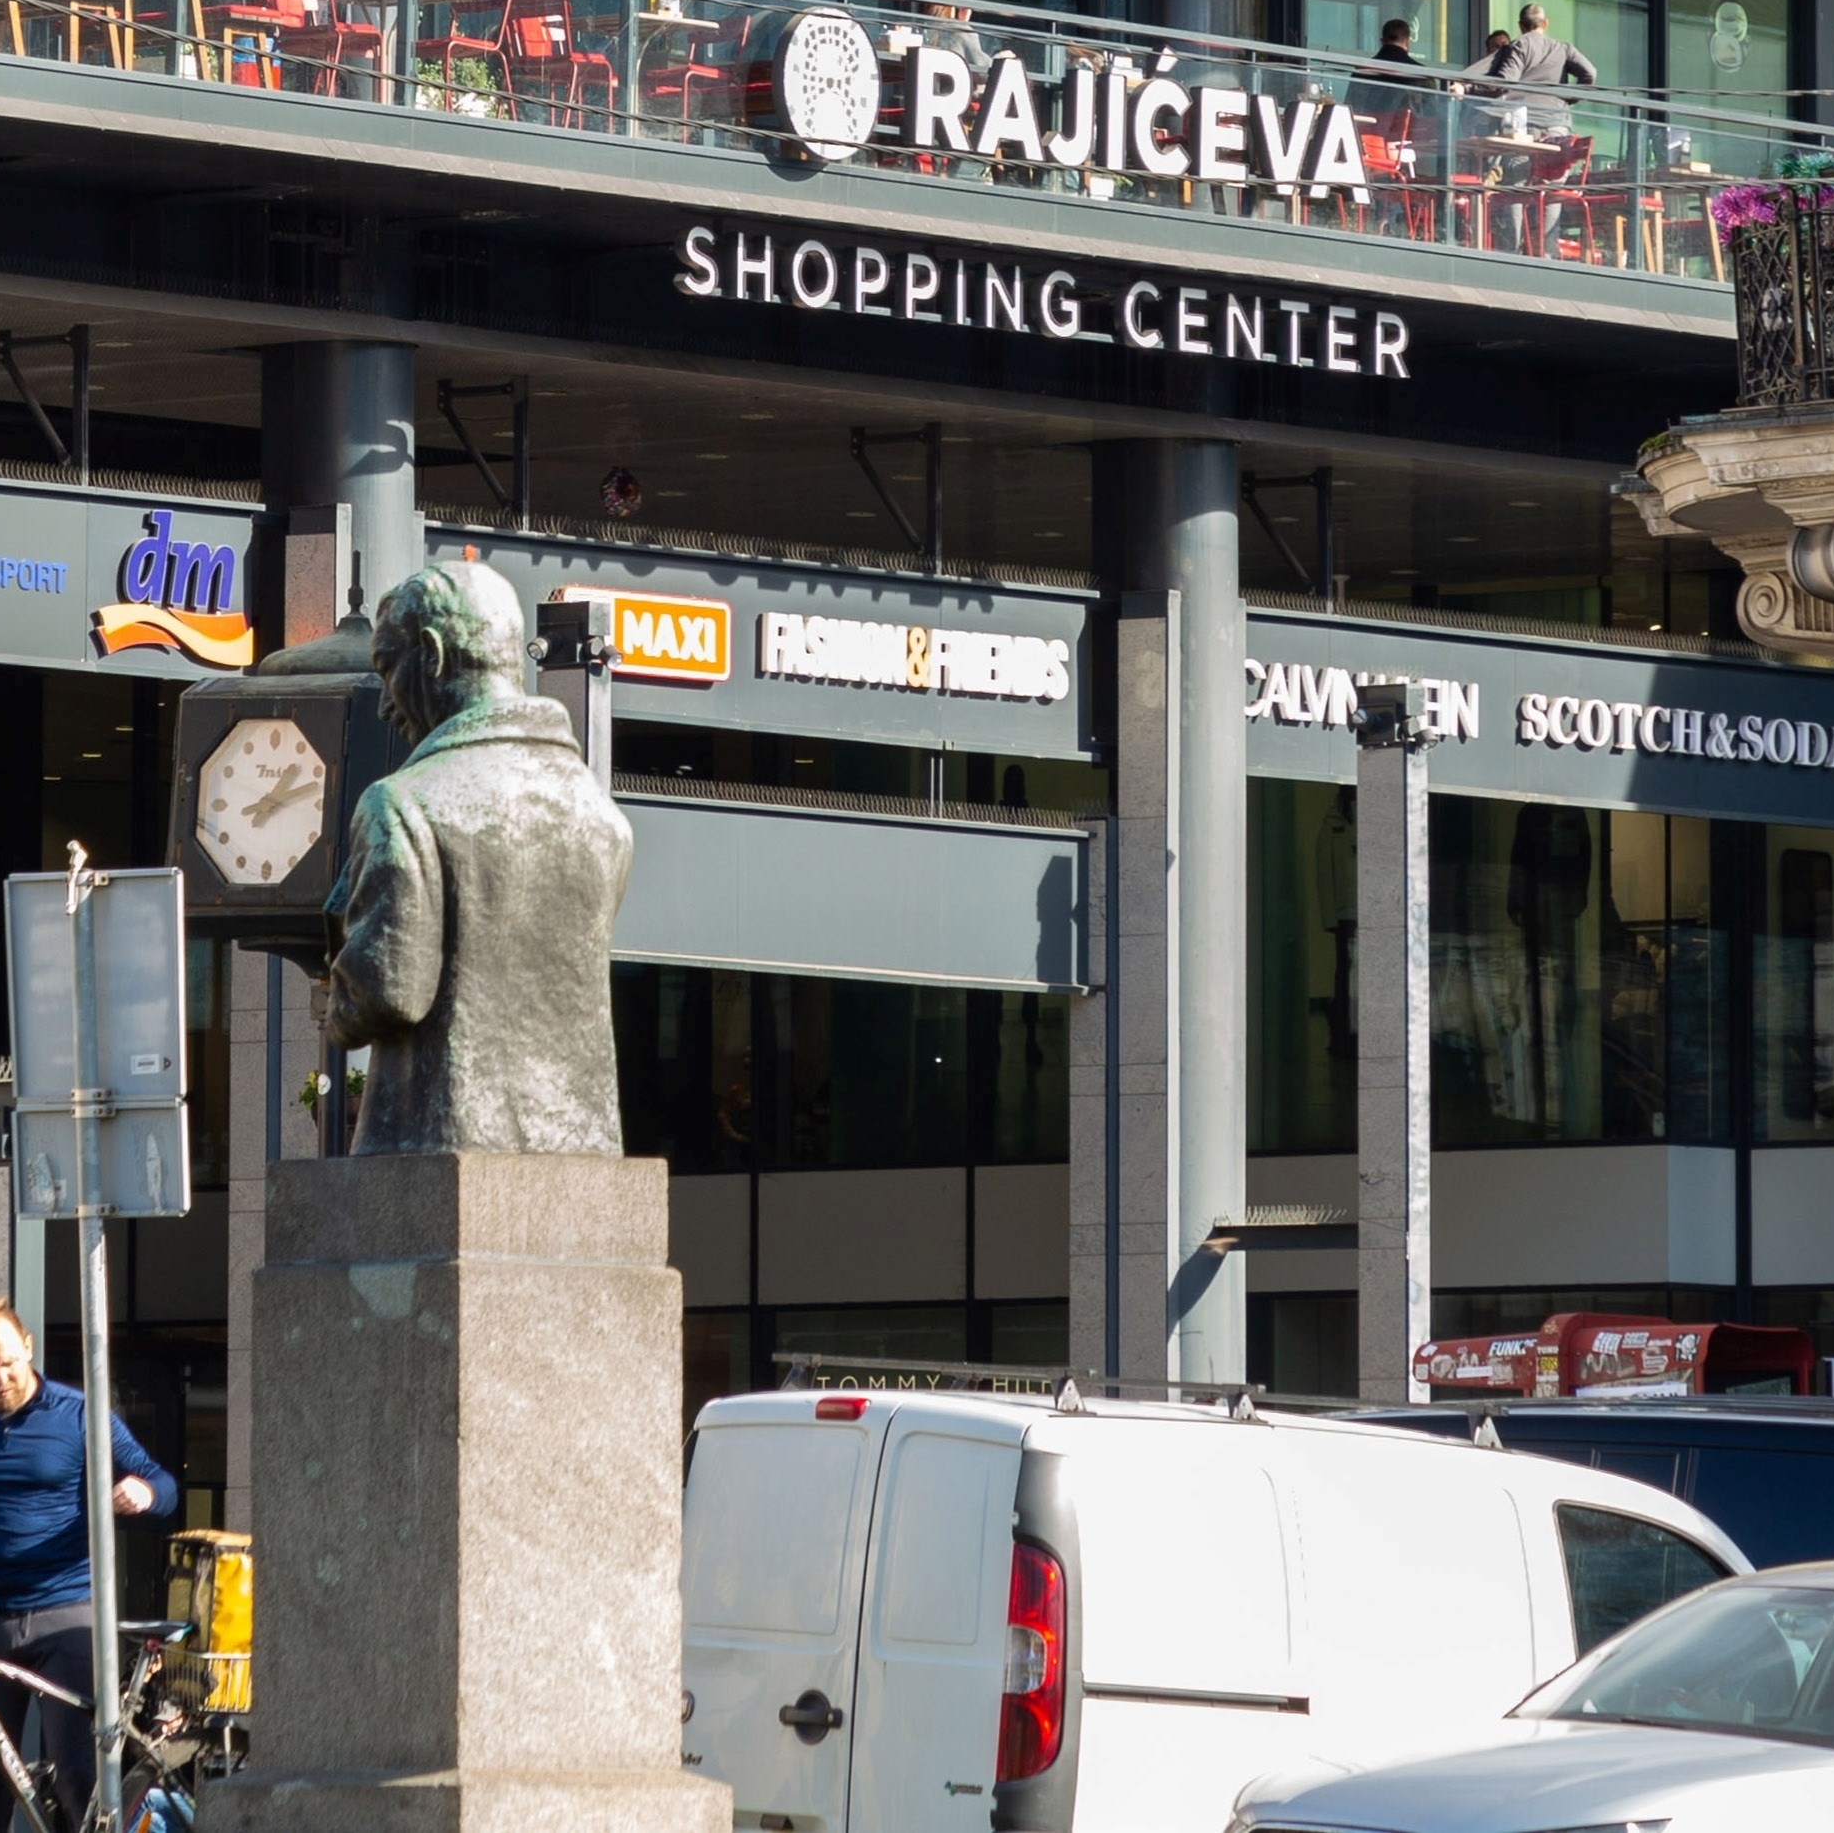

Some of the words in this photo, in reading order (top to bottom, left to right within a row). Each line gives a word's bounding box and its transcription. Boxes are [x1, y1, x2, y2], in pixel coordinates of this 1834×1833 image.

[905, 47, 1371, 204] RAJIĆEVA
[673, 225, 1081, 340] SHOPPING
[1117, 279, 1411, 379] CENTER
[117, 510, 235, 613] dm
[622, 609, 718, 664] MAXI
[816, 1374, 941, 1391] TOMMY
